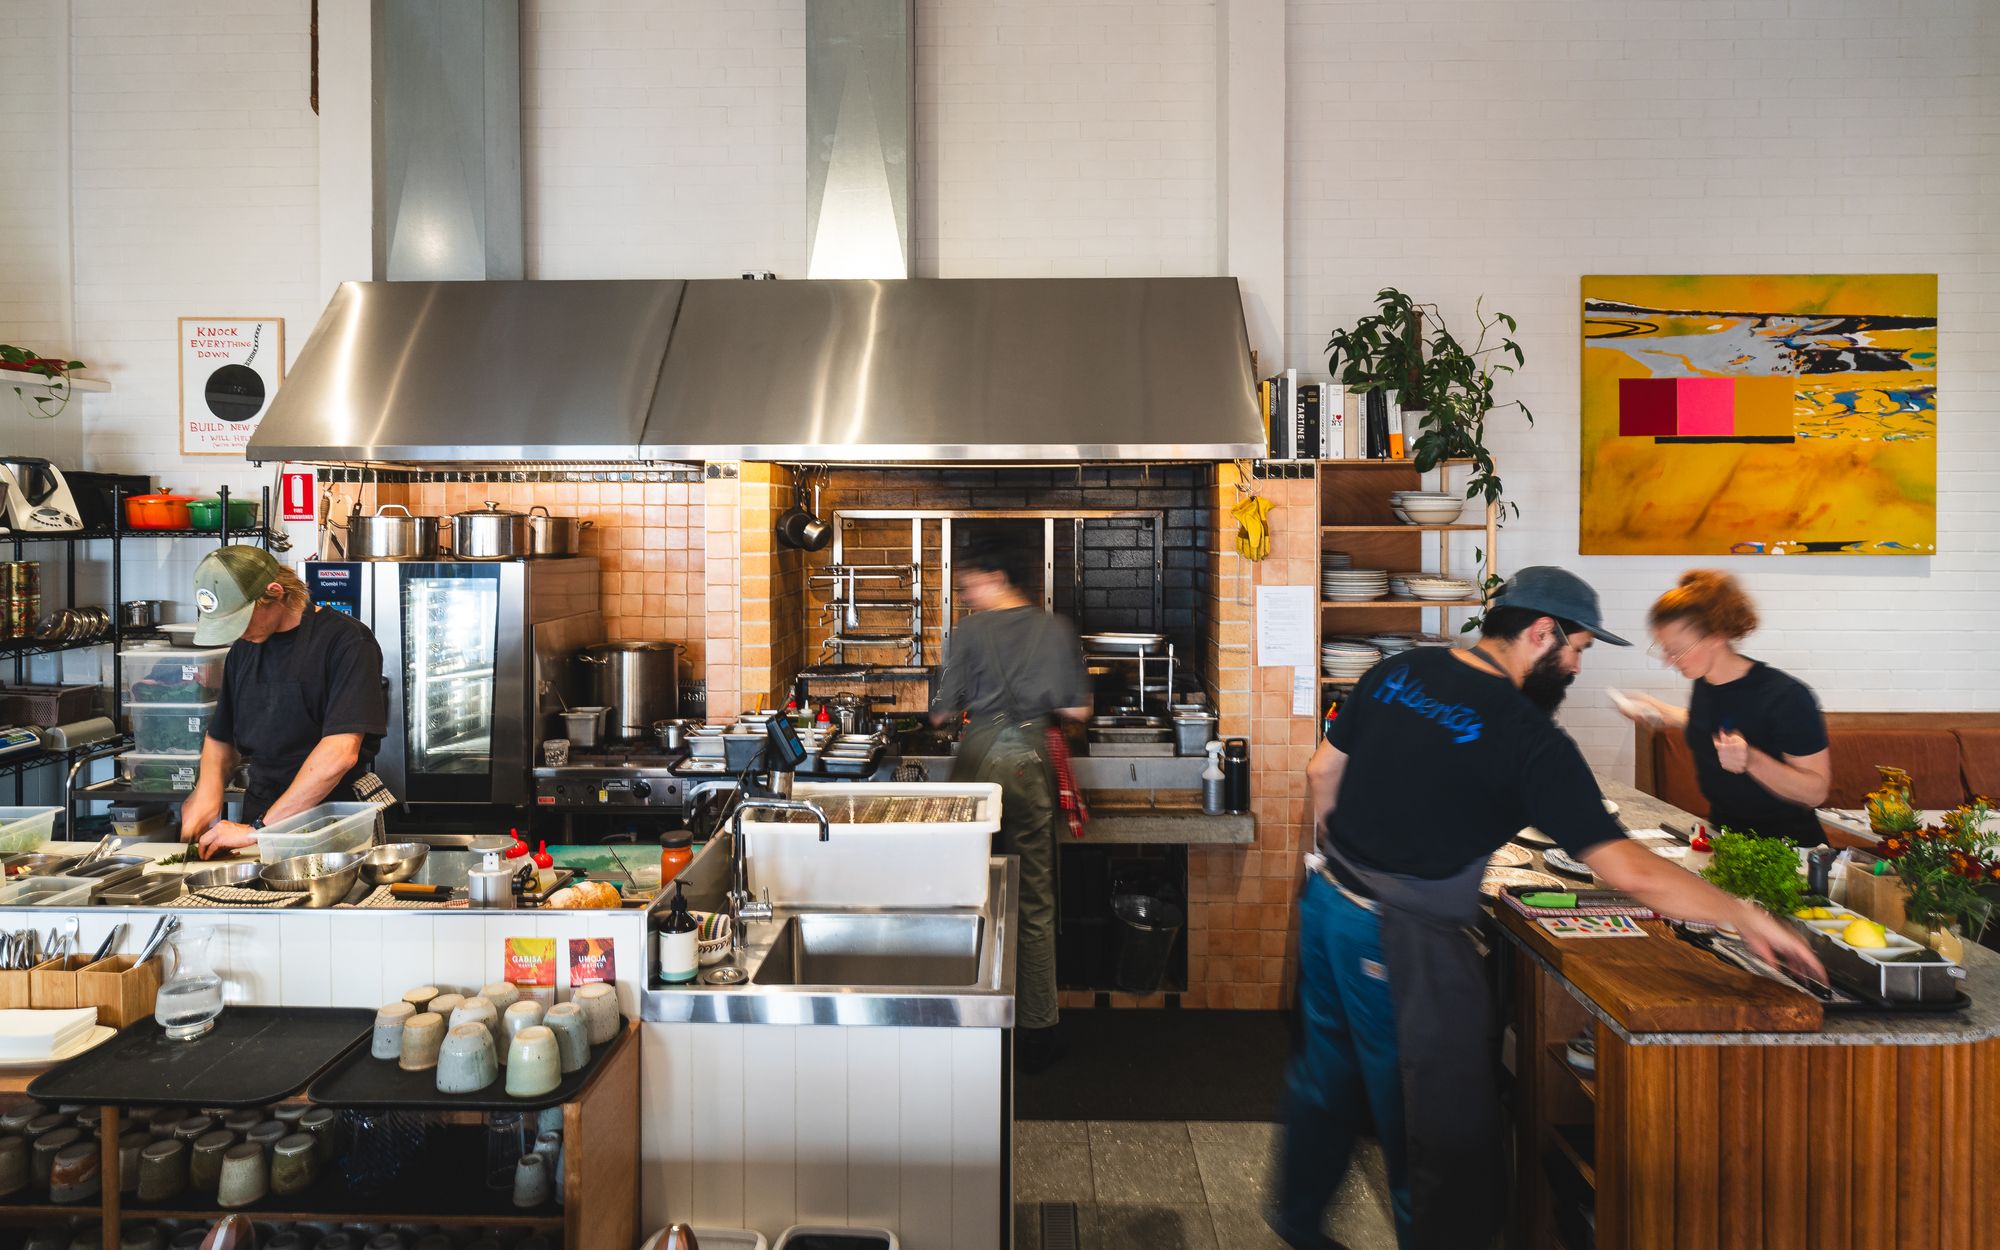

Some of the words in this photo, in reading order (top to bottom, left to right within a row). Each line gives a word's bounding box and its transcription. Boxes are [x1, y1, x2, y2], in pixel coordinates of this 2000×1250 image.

[197, 327, 238, 336] KNOCK
[191, 340, 252, 348] EVERYTHING
[1297, 402, 1305, 439] TARTINE
[190, 422, 224, 432] BUILD
[230, 423, 250, 431] NEW
[578, 954, 607, 963] UMOJA
